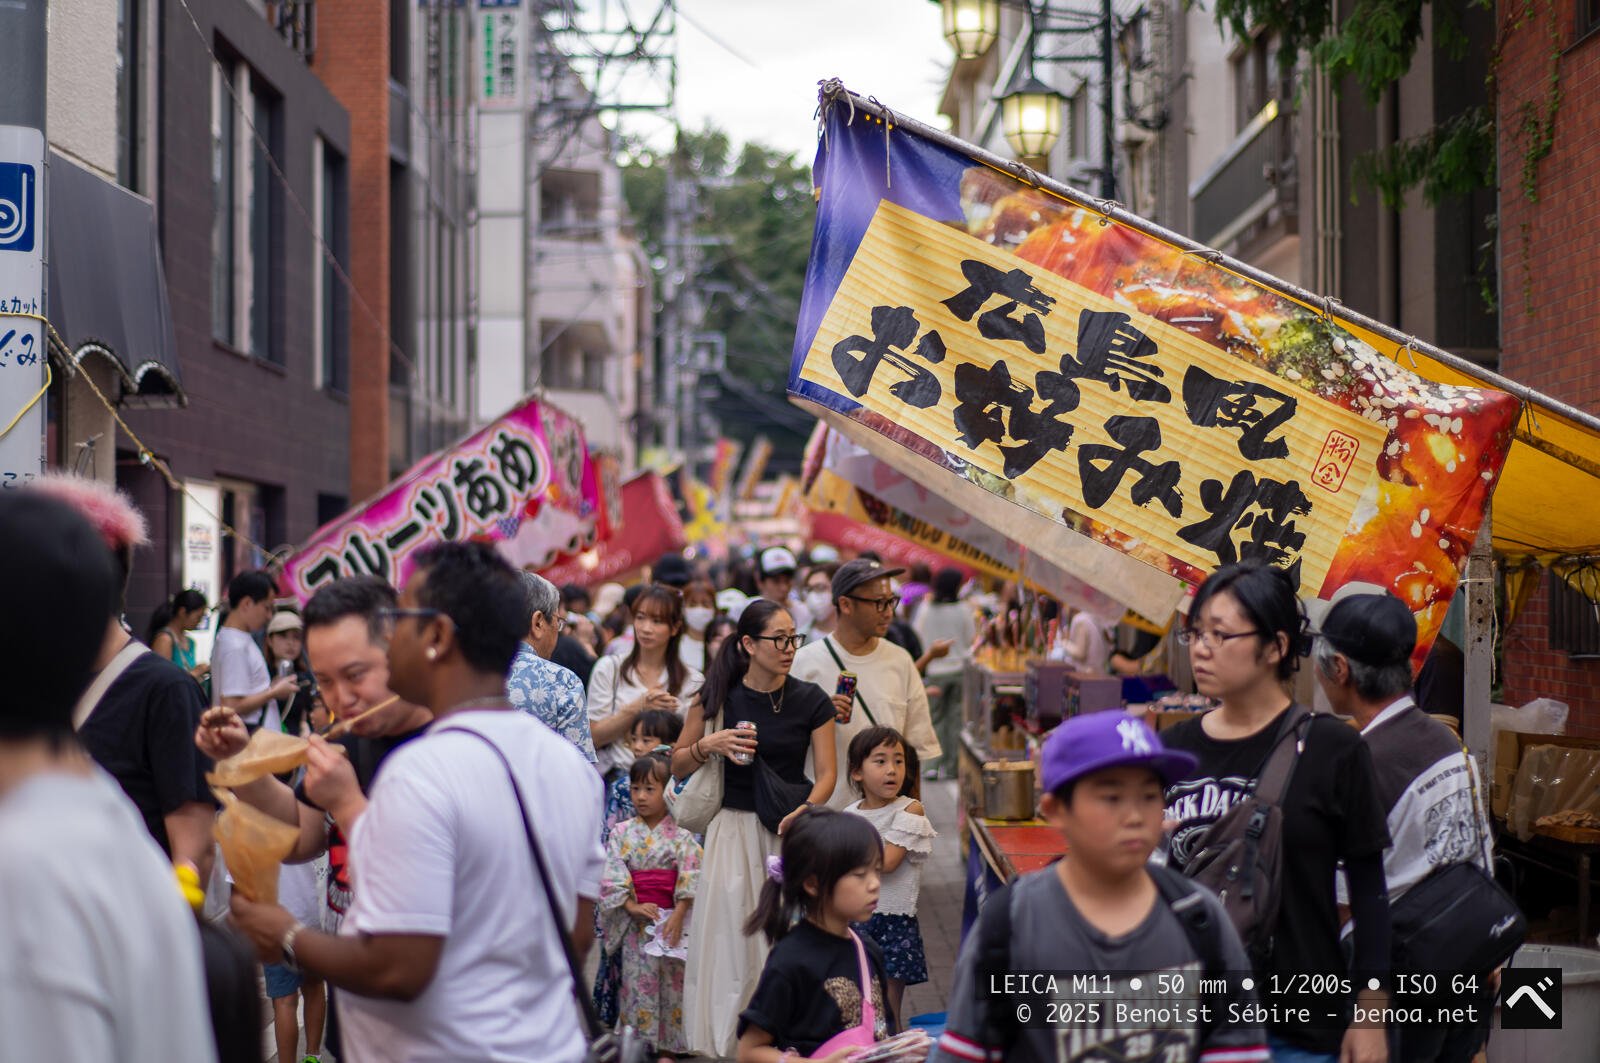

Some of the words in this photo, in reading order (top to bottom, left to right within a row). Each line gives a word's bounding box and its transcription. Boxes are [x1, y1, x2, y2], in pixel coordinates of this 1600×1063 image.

[940, 259, 1298, 462] 広島風
[1163, 793, 1199, 820] ACK
